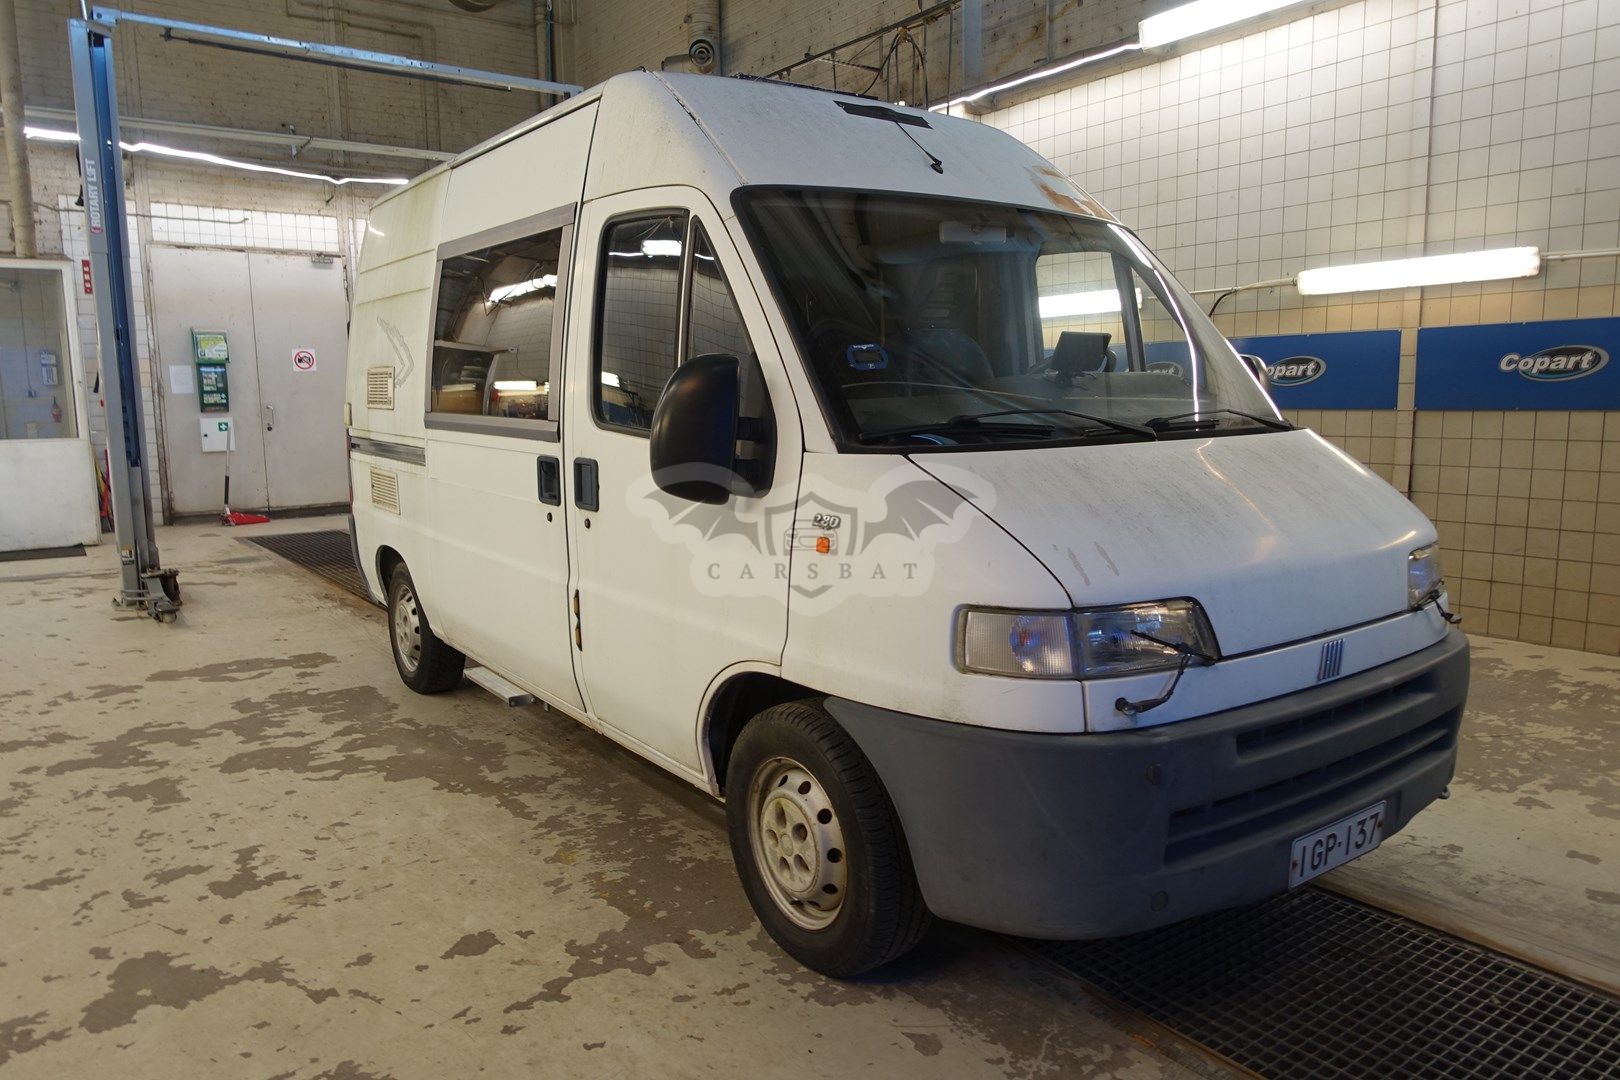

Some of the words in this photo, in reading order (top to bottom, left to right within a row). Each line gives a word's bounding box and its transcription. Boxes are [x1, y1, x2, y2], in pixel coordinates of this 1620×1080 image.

[85, 158, 97, 181] LIFT
[87, 183, 101, 227] ROTARY
[1266, 360, 1316, 380] opart
[1500, 351, 1594, 374] Copart
[1300, 812, 1380, 877] IGP-137
